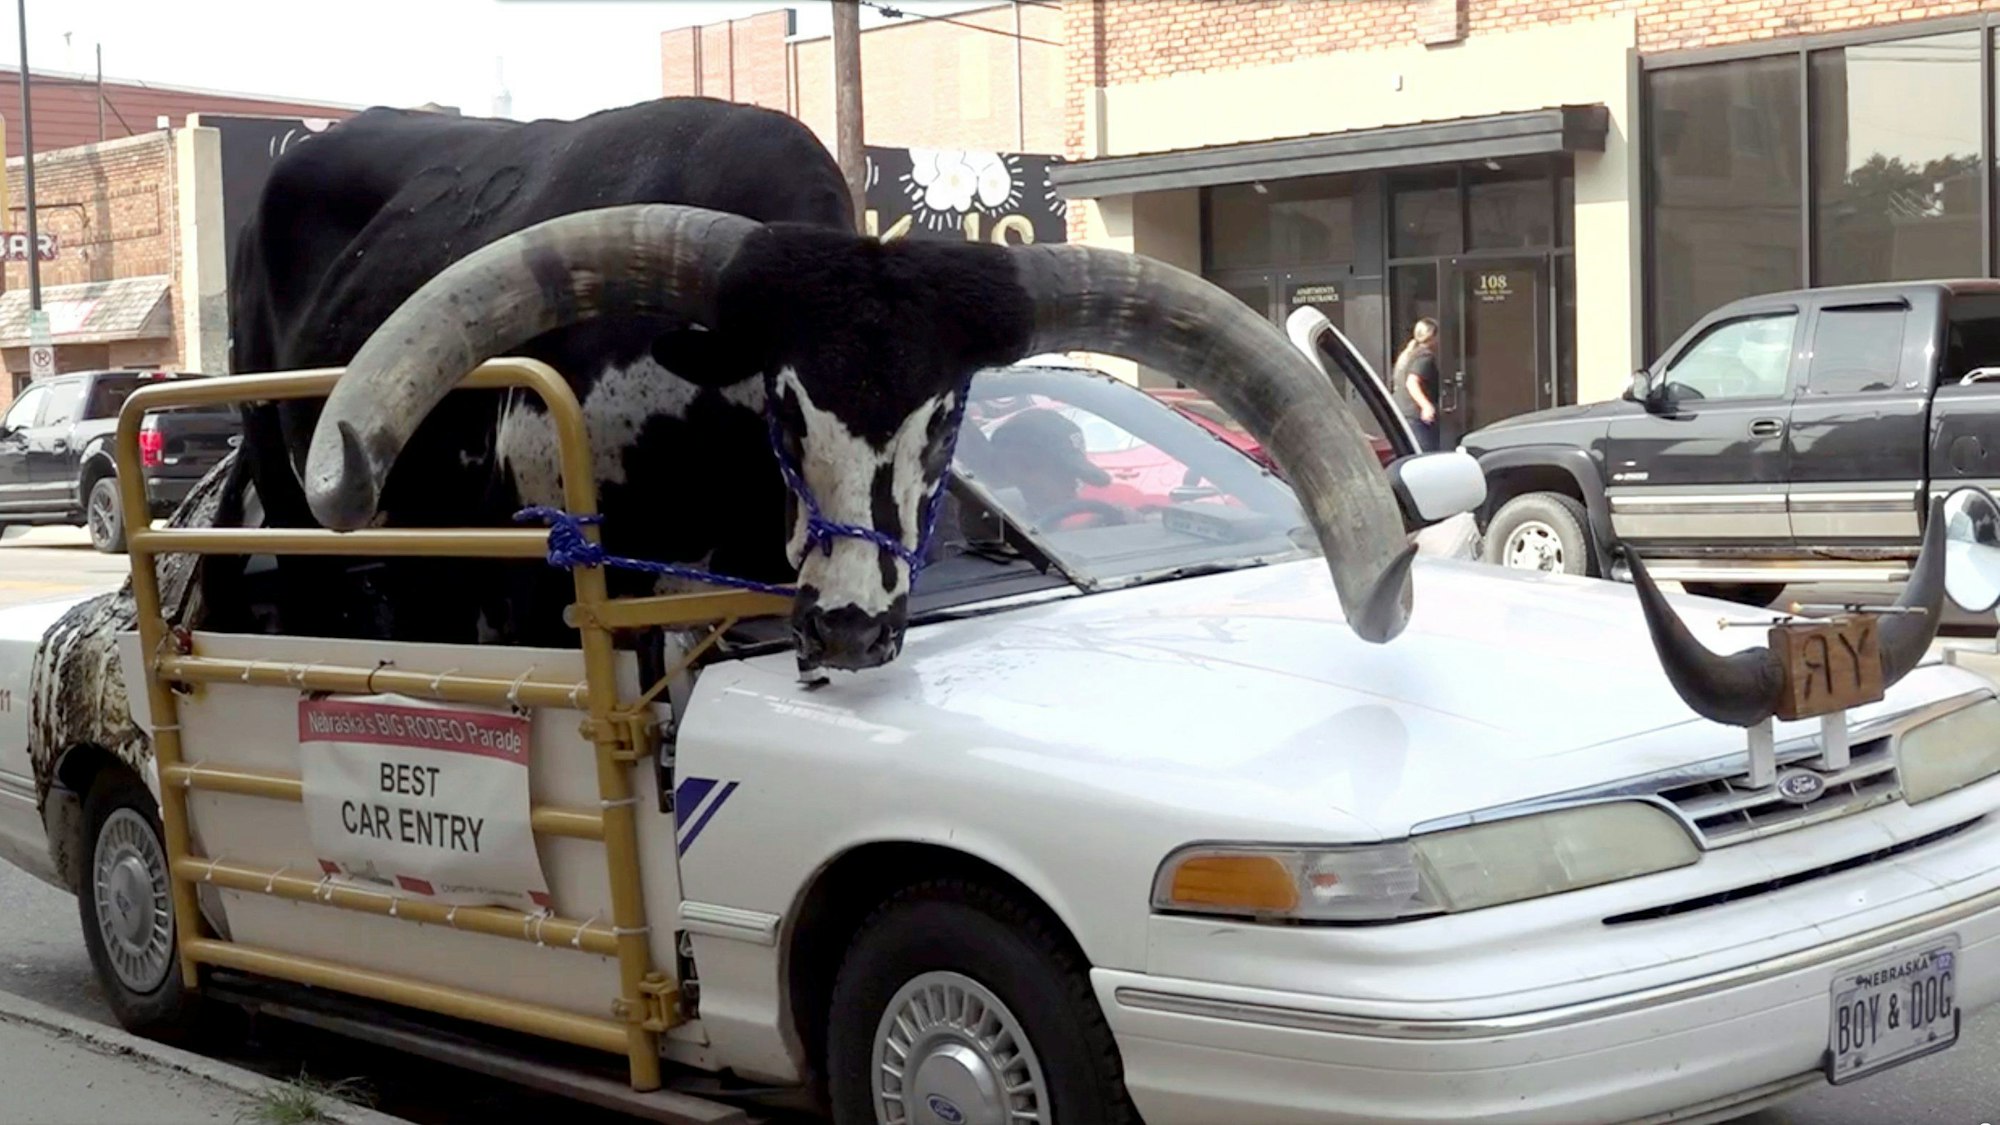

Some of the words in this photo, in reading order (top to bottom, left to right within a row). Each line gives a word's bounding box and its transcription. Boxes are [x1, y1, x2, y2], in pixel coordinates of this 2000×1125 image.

[1481, 274, 1507, 289] 108
[308, 711, 376, 735] Nebraska's
[375, 713, 404, 737] BIG
[405, 714, 465, 744] RODEO
[466, 722, 522, 753] Parade
[380, 762, 440, 798] BEST
[341, 800, 392, 840] CAR
[399, 808, 484, 853] ENTRY
[1864, 957, 1929, 988] NEBRASKA
[1838, 993, 1881, 1057] BOY
[1887, 993, 1901, 1030] &
[1911, 971, 1952, 1030] DOG
